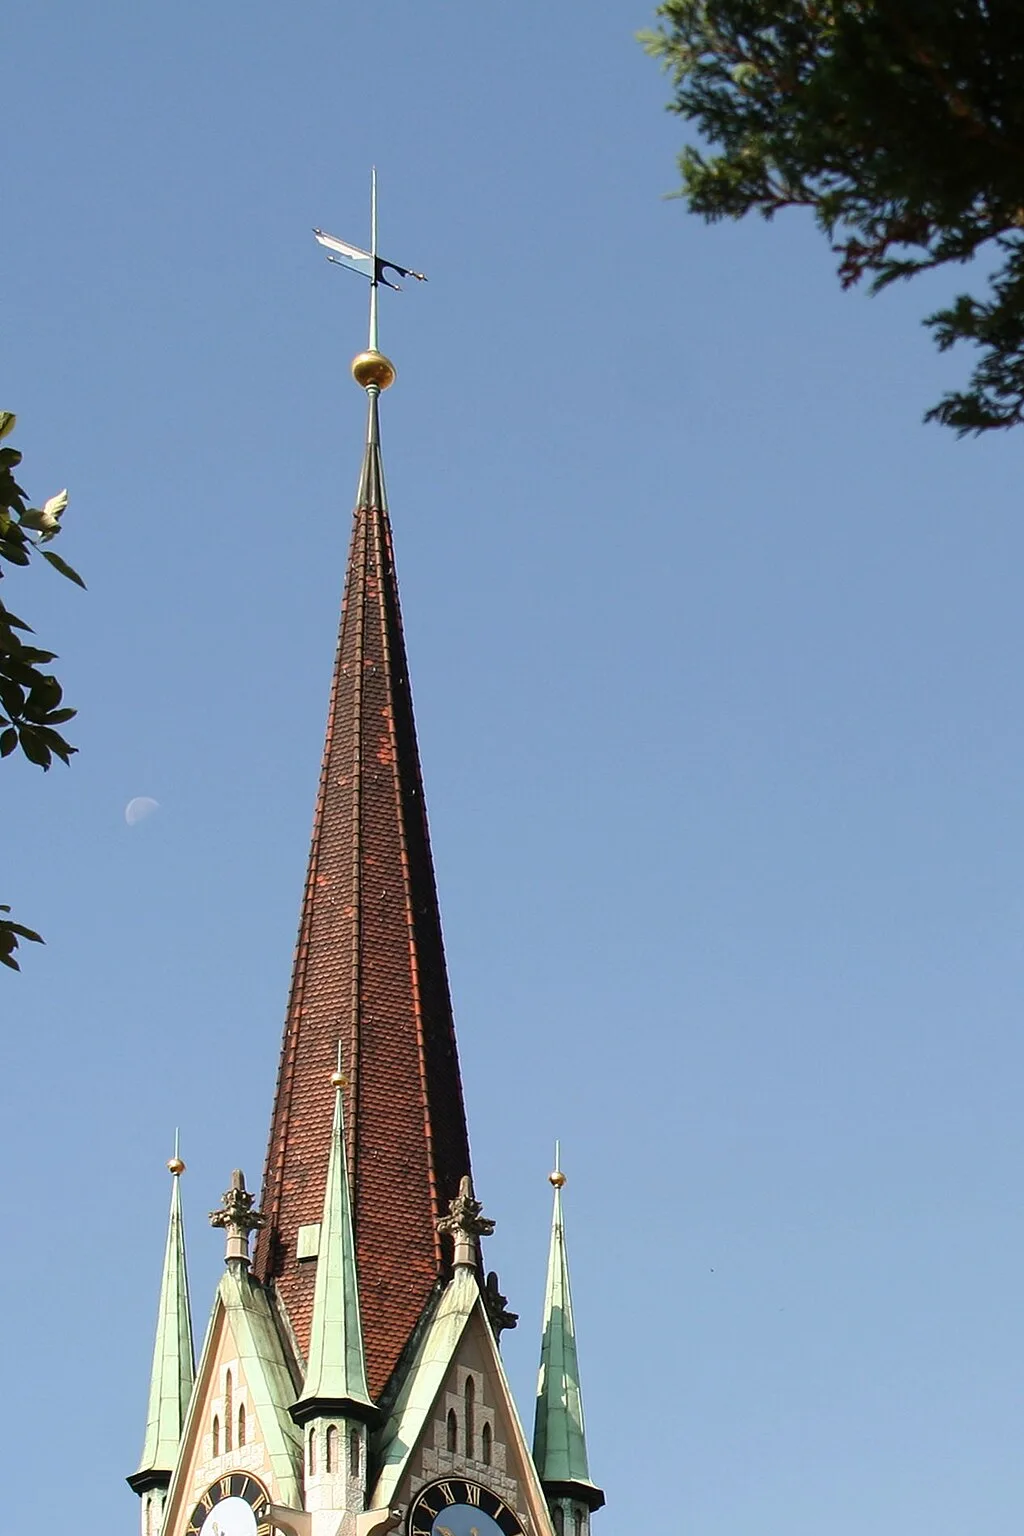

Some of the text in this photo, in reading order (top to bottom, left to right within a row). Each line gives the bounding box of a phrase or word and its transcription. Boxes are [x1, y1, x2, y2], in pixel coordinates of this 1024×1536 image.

[240, 1477, 249, 1497] I
[438, 1483, 456, 1504] XI
[465, 1484, 481, 1507] XII
[251, 1494, 265, 1511] II
[418, 1497, 438, 1518] X
[494, 1504, 505, 1519] I
[187, 1522, 200, 1536] X
[257, 1523, 270, 1536] III
